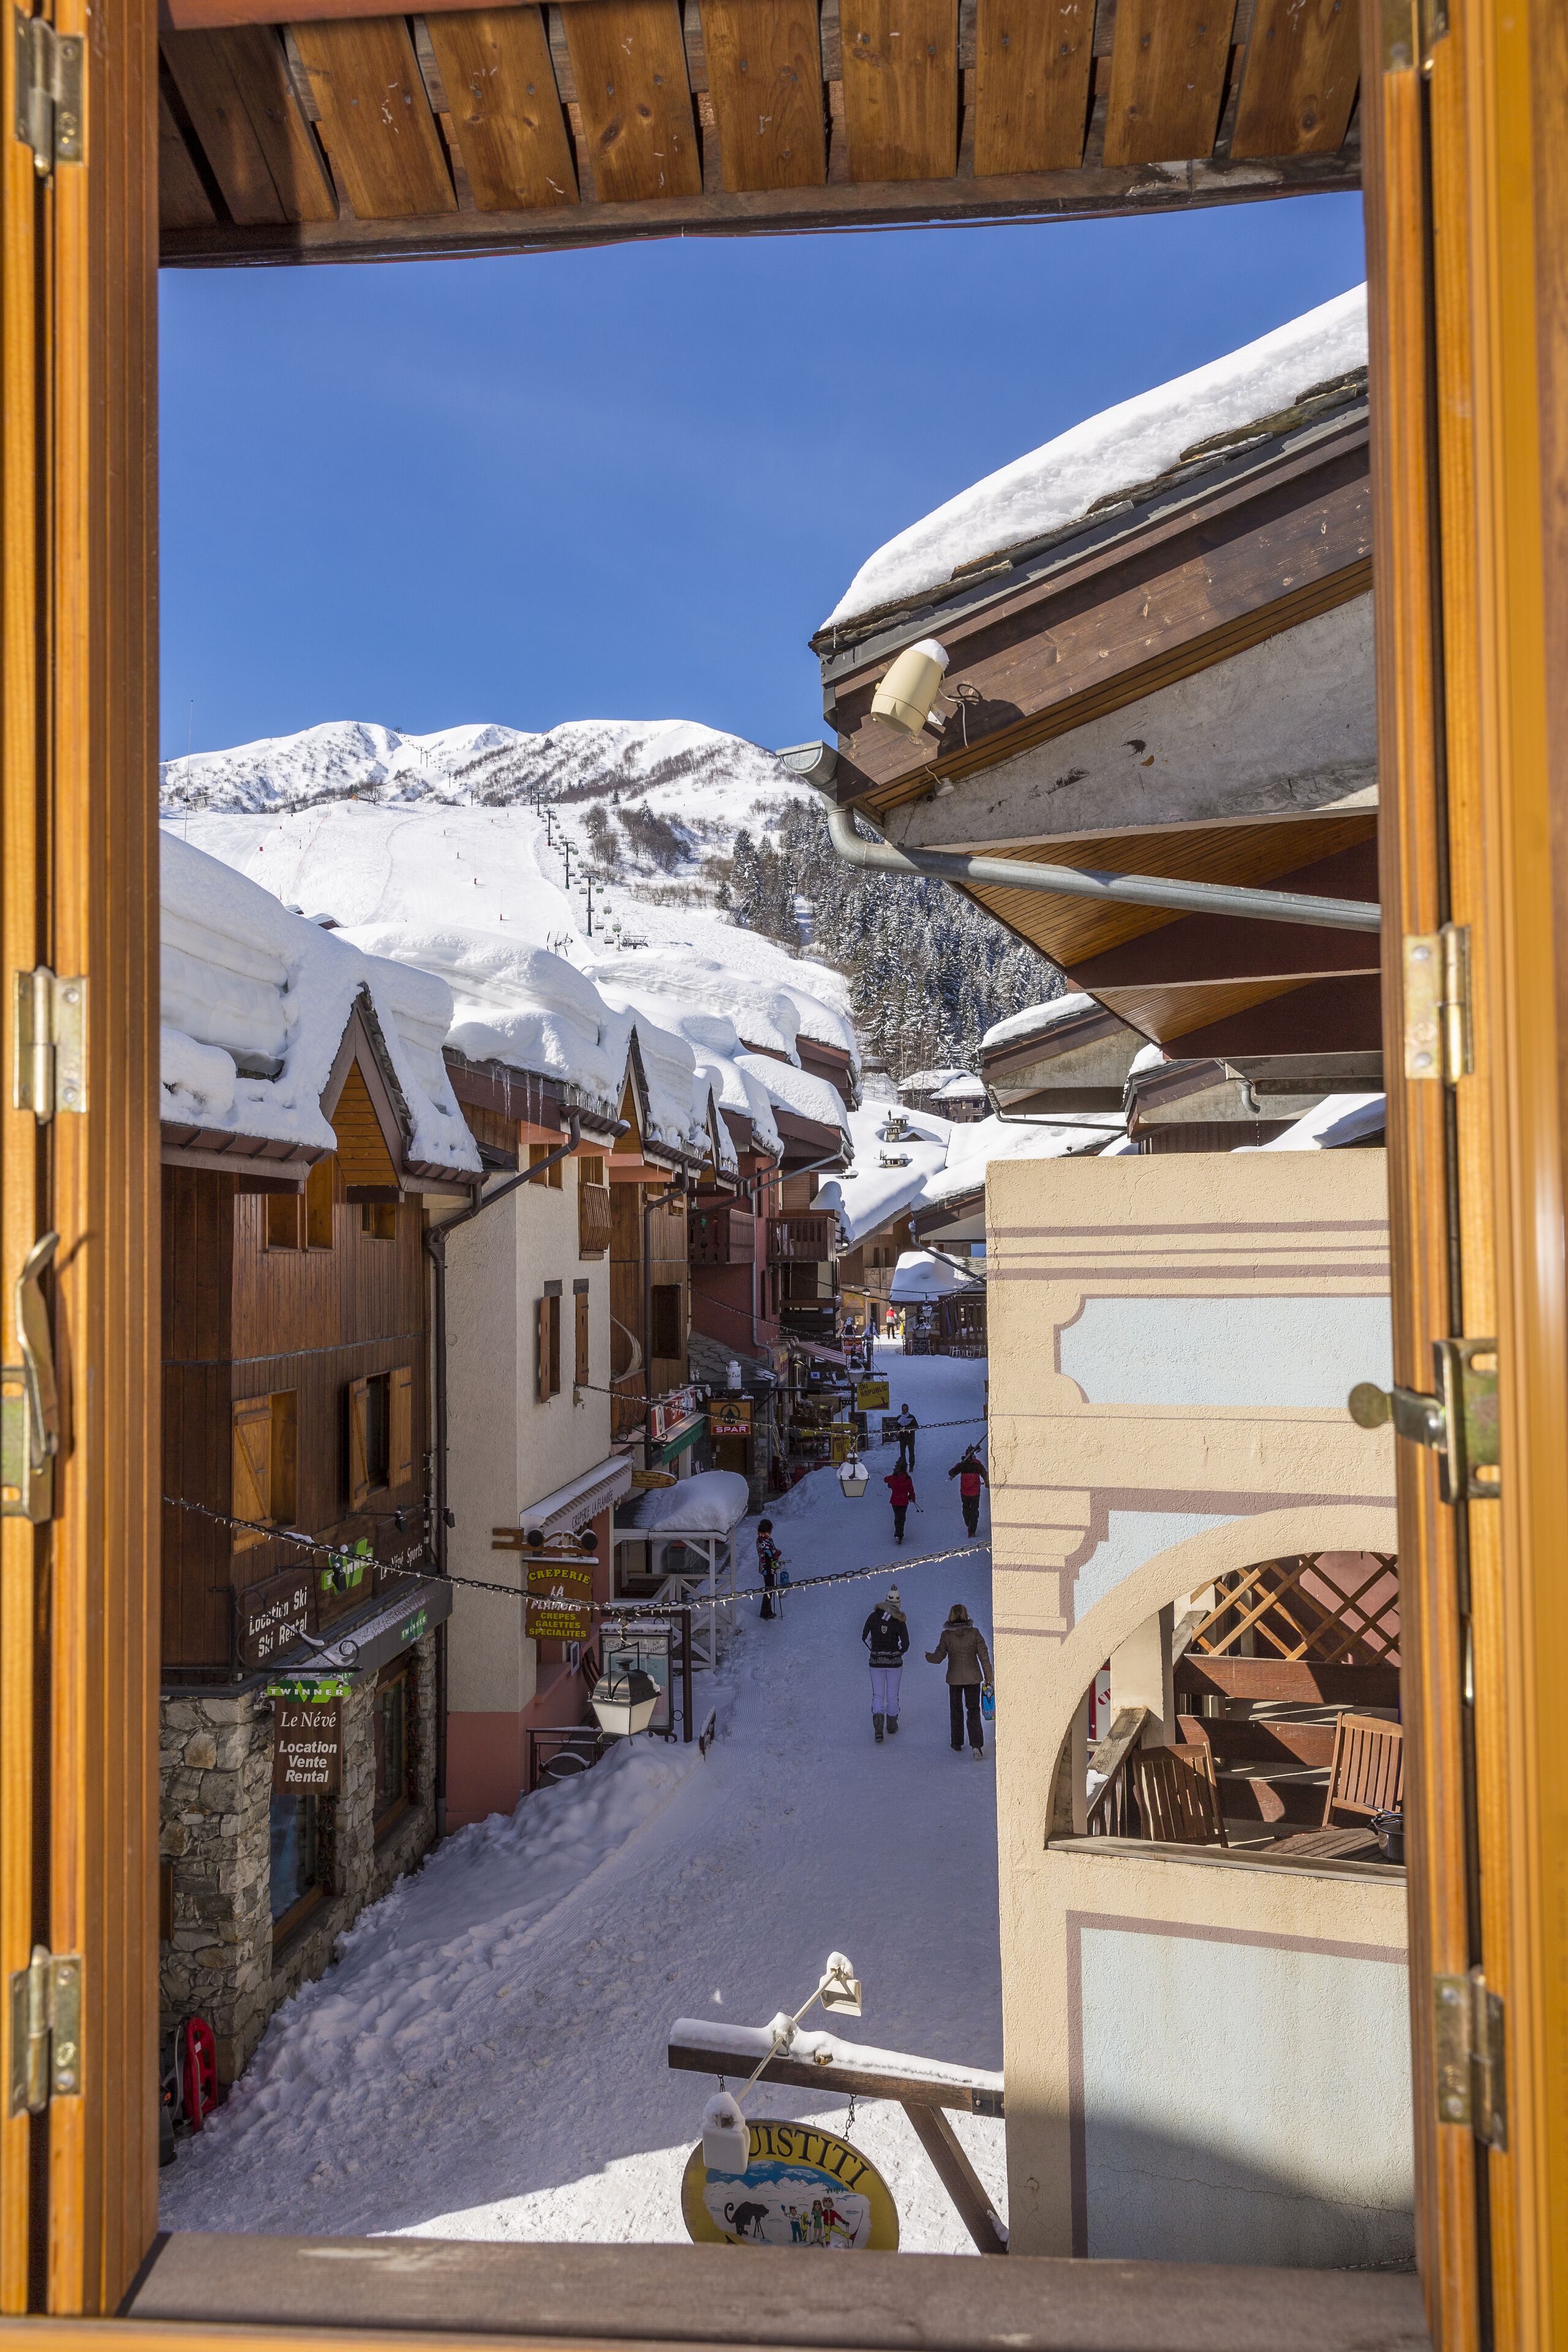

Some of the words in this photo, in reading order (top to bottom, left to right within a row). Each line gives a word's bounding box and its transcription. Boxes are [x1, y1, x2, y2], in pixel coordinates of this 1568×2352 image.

[407, 1543, 423, 1567] Sports
[528, 1569, 590, 1585] CREPERIE
[550, 1585, 564, 1597] LA
[249, 1601, 289, 1637] Location
[293, 1586, 307, 1610] Ski
[540, 1612, 576, 1621] CREPES
[402, 1616, 426, 1638] TWINNER
[535, 1620, 581, 1629] GALETTES
[529, 1628, 587, 1638] SPECIALITES
[258, 1630, 274, 1658] Ski
[280, 1711, 298, 1727] Le
[300, 1711, 337, 1727] Névé
[279, 1740, 337, 1754] Location
[288, 1755, 327, 1768] Vente
[285, 1770, 330, 1783] Rental
[748, 2125, 870, 2190] UISTITI
